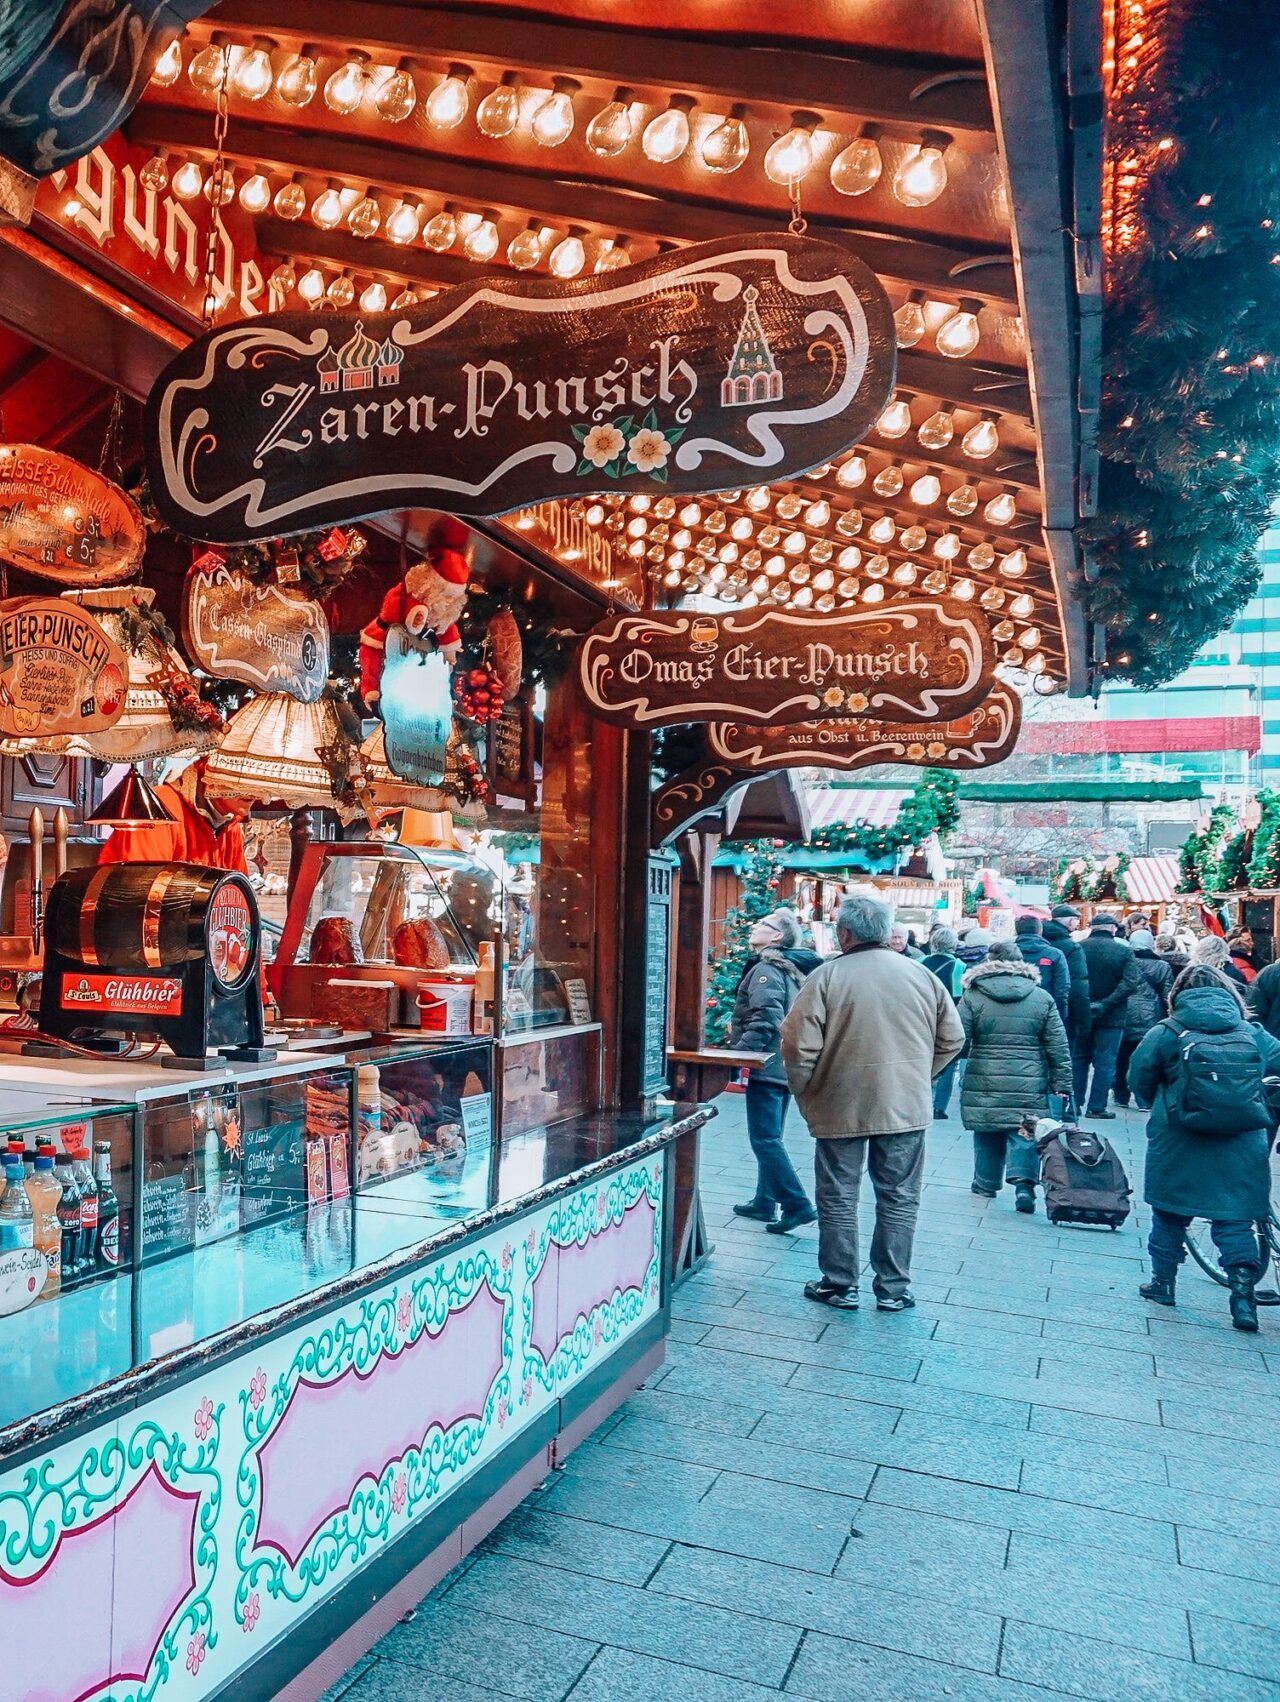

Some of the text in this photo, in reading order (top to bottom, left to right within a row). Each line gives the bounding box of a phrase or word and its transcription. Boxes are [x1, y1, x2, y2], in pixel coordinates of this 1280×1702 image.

[253, 334, 699, 469] Zaren-Punsch
[4, 613, 106, 672] EIER-PUNSCH
[22, 649, 44, 662] HEISS
[45, 649, 58, 661] UND
[619, 641, 929, 690] Omas Eier-Punsch
[788, 728, 945, 745] aus Obst u. Beerenwein
[105, 980, 176, 1002] Glühbier
[64, 1219, 80, 1227] zero
